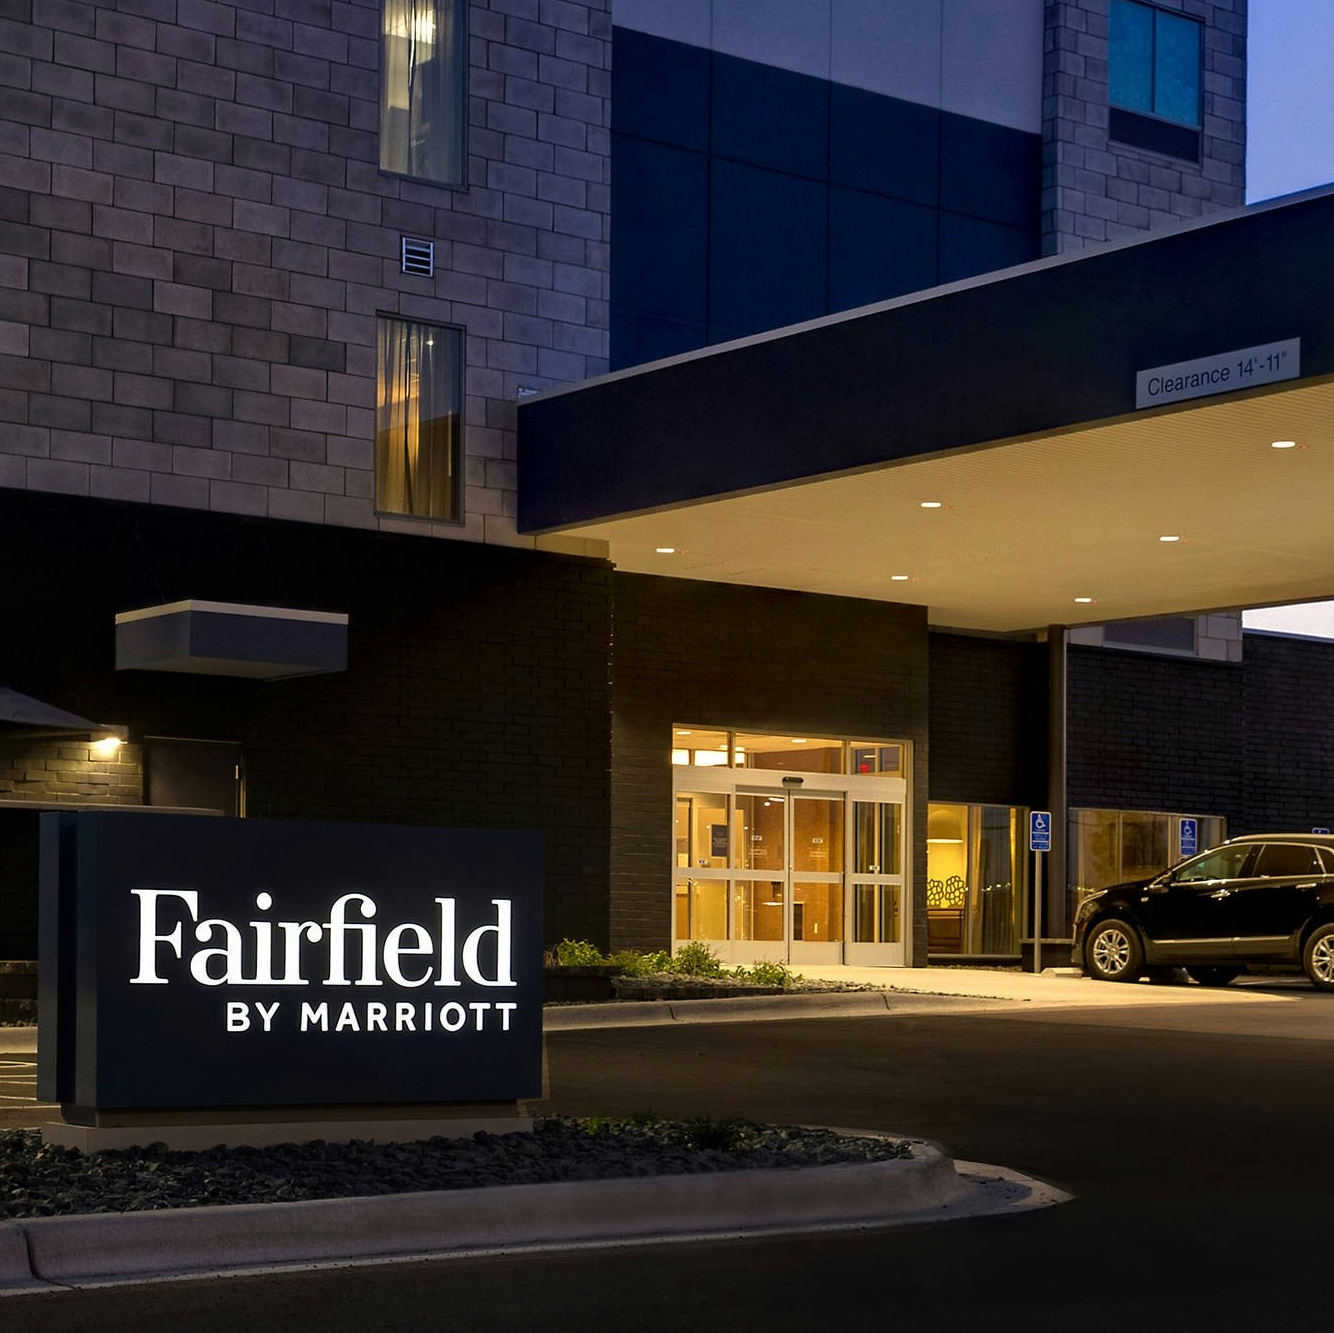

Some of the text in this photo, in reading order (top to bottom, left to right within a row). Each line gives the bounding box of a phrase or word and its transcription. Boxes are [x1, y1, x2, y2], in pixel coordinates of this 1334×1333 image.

[1147, 365, 1231, 396] Clearance
[129, 888, 519, 988] Fairfield
[225, 1000, 518, 1033] BY MARRIOTT
